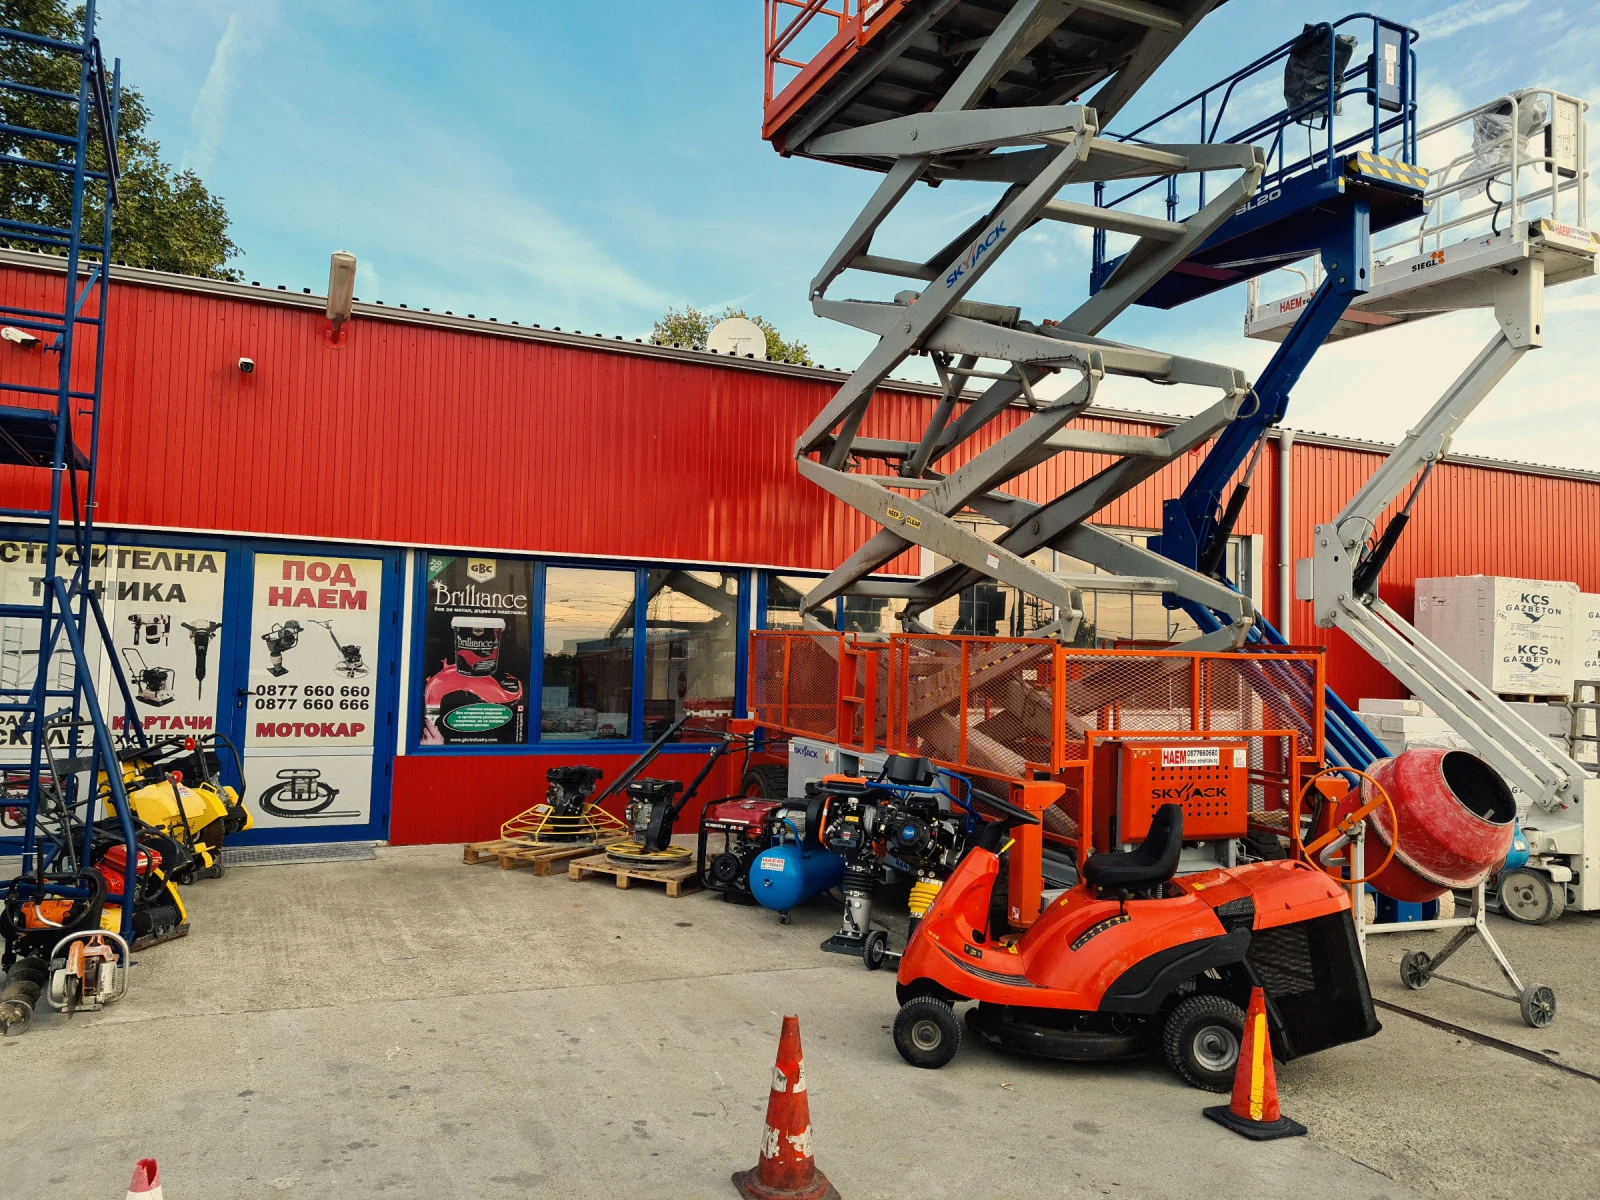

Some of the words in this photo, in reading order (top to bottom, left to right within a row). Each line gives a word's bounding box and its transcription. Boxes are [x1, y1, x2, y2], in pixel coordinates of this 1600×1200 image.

[1235, 188, 1282, 216] SL20
[946, 219, 1007, 289] SKYJACK
[1411, 259, 1438, 272] SIEGL
[0, 542, 218, 573] СТРОИТЕЛНА
[282, 560, 357, 588] ПОД
[470, 562, 493, 574] GBC
[28, 576, 187, 603] ТНИКА
[434, 583, 528, 609] Brilliance
[268, 586, 368, 611] НАЕМ
[1520, 592, 1550, 606] KÇS
[1505, 604, 1562, 615] GAZBETON
[457, 636, 493, 648] Brilliance
[1517, 644, 1549, 657] KÇS
[1503, 655, 1561, 666] GAZBETON
[256, 684, 299, 697] 0877
[303, 685, 334, 697] 660
[339, 685, 370, 698] 660
[255, 698, 298, 710] 0877
[302, 699, 334, 711] 660
[339, 699, 369, 711] 666
[255, 722, 366, 738] МОТОКАР
[794, 745, 818, 759] SKYJACK
[1151, 782, 1228, 801] SKYJACK
